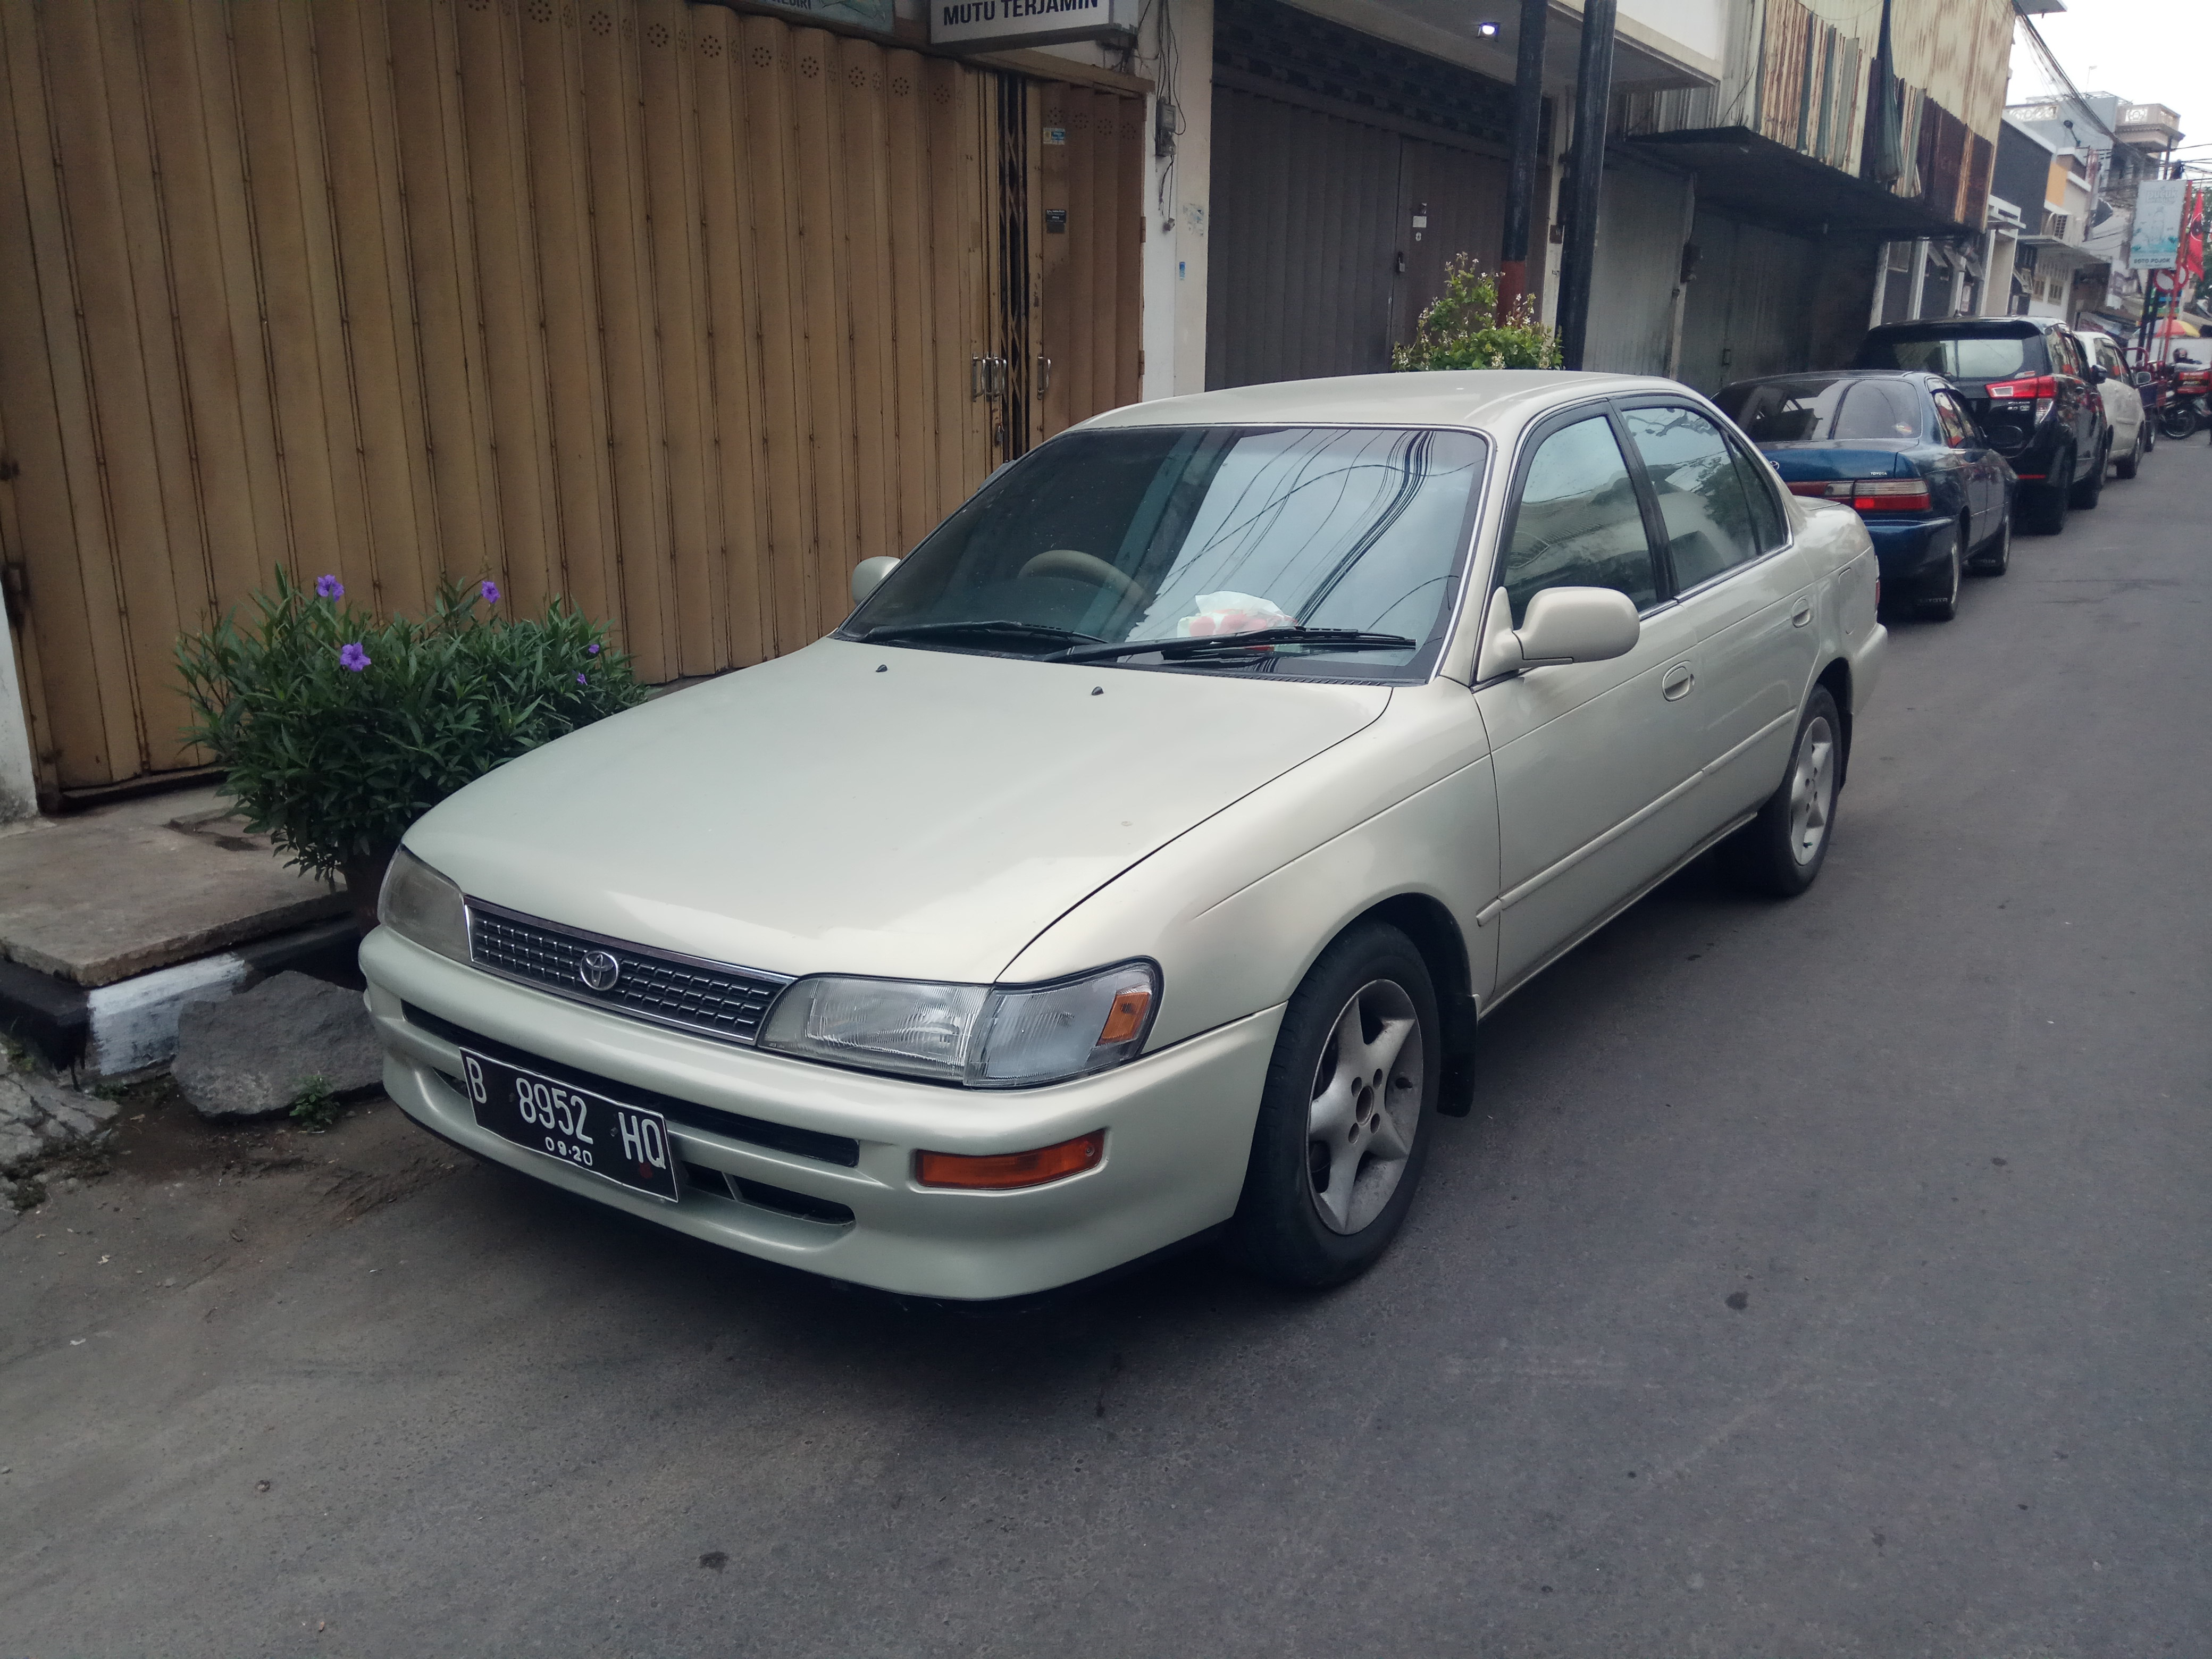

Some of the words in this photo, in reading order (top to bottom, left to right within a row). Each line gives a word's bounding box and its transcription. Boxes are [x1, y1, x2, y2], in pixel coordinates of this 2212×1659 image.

[943, 1, 995, 25] MUTU
[466, 1057, 487, 1103] B
[516, 1077, 593, 1144] 8952
[618, 1112, 666, 1169] HQ
